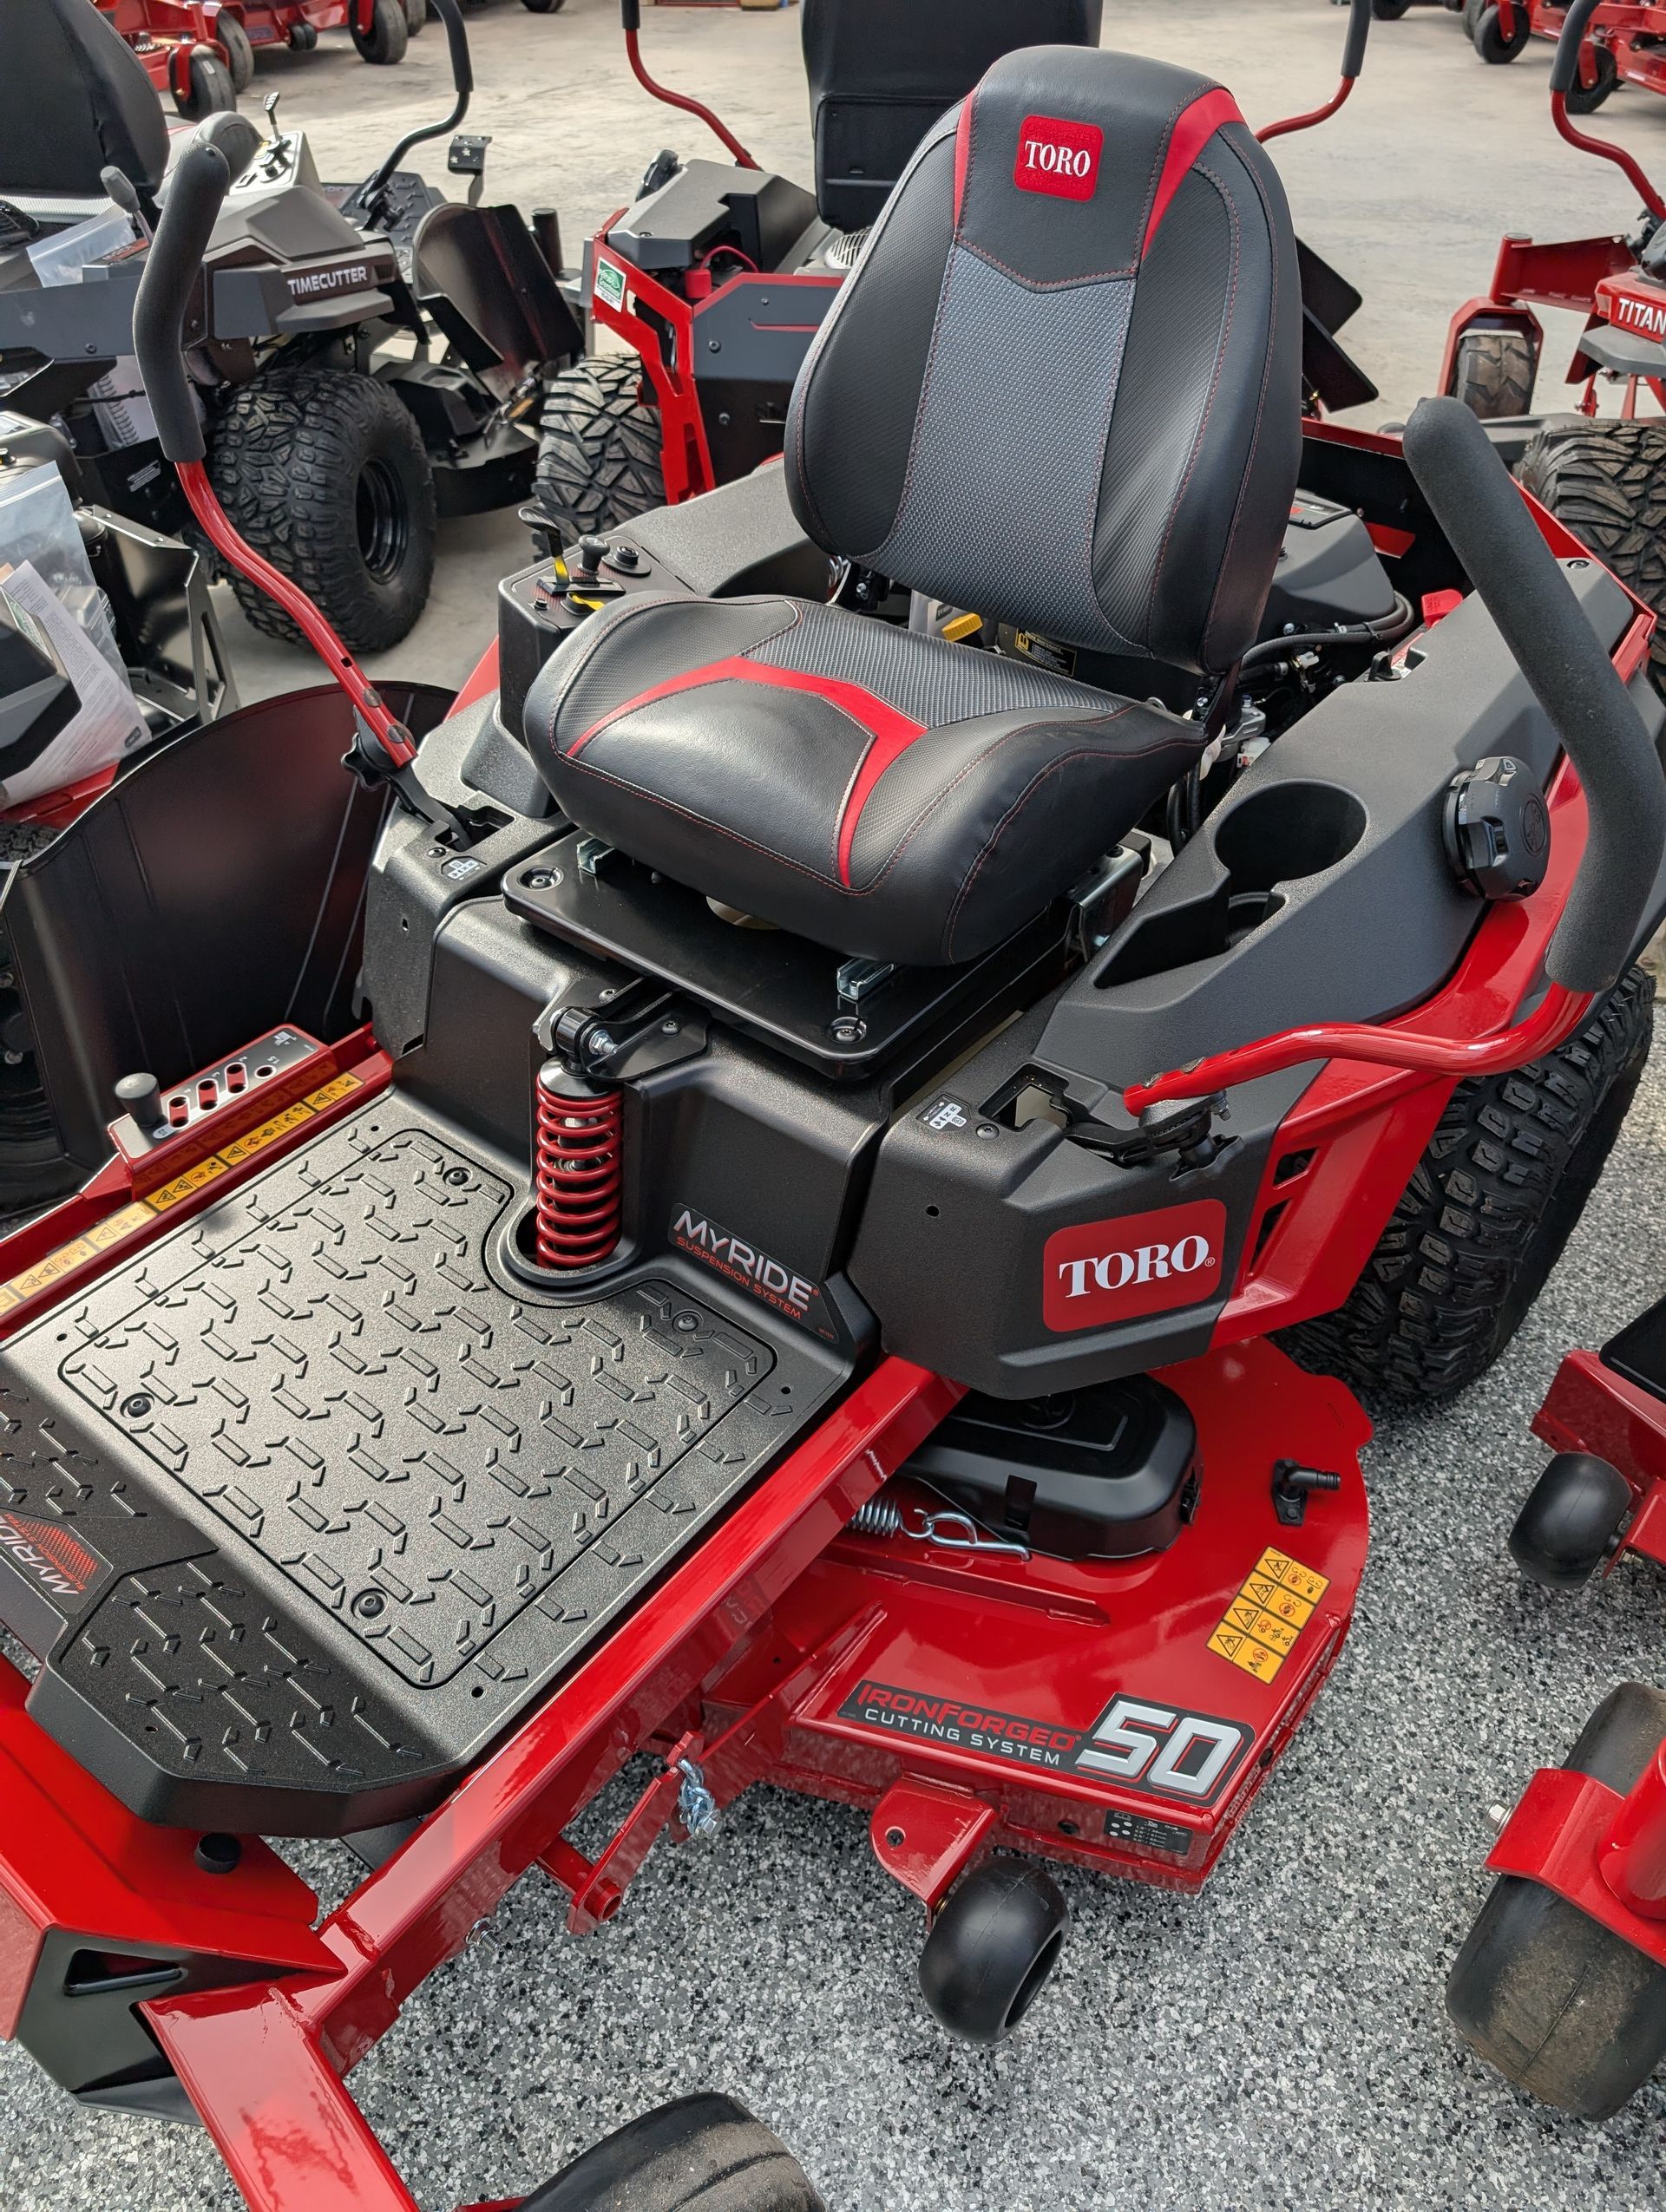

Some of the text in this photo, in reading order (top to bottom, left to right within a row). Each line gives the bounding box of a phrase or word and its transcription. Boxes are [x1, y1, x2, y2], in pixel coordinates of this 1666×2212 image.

[1025, 141, 1091, 178] TORO
[287, 265, 368, 295] TIMECUTTER
[676, 1236, 802, 1319] SUSPENSION SYSTEM
[0, 1515, 80, 1594] MYRID
[864, 1707, 1060, 1766] CUTTING SYSTEM
[1074, 1699, 1243, 1799] 50
